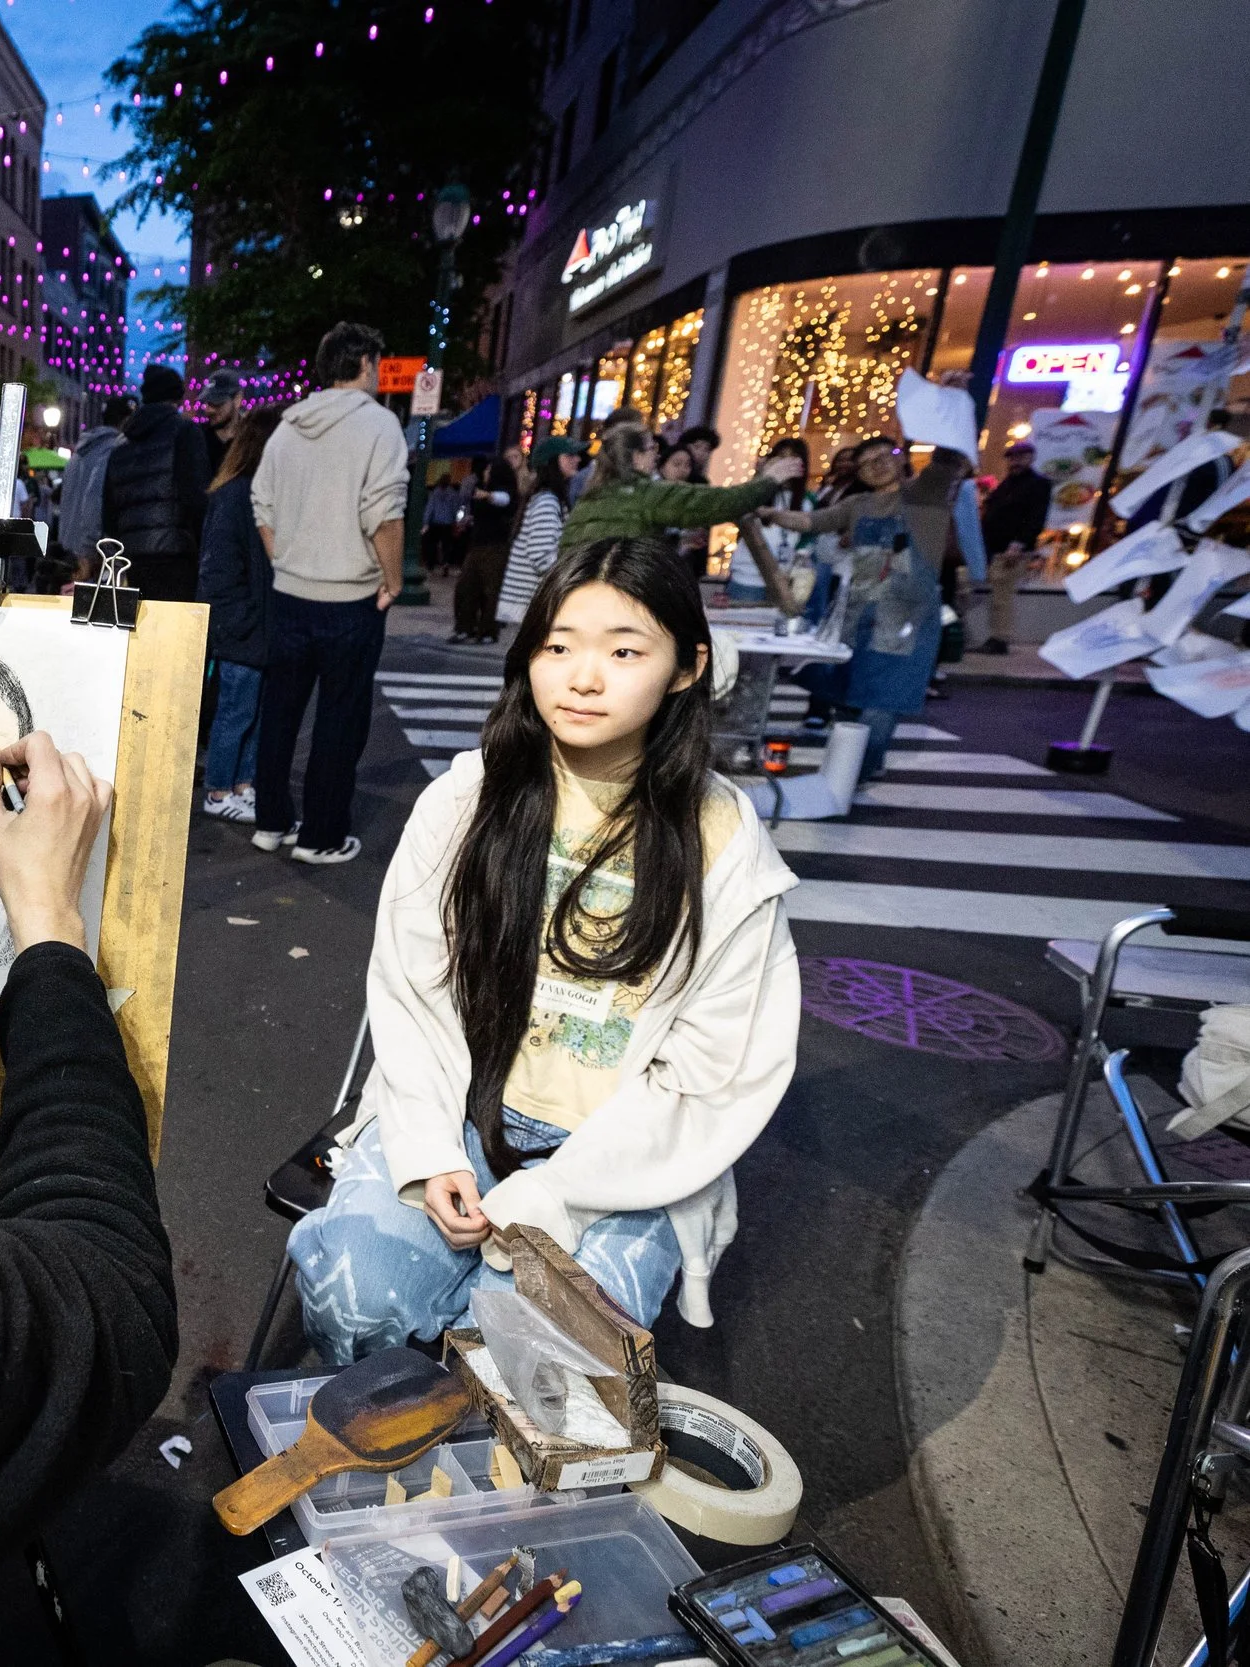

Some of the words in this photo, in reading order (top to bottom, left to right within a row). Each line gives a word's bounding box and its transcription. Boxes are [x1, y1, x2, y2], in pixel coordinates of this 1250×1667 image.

[1017, 352, 1107, 374] OPEN
[392, 375, 415, 385] WOR
[567, 989, 598, 1006] GOGH
[295, 1562, 332, 1597] October
[280, 1615, 304, 1646] Instagram
[299, 1613, 309, 1625] 315
[307, 1624, 320, 1640] Peck
[318, 1640, 335, 1662] Street,
[322, 1611, 334, 1626] Over
[334, 1627, 345, 1639] 100
[343, 1640, 358, 1659] artists
[336, 1617, 346, 1629] See
[345, 1630, 354, 1641] art.
